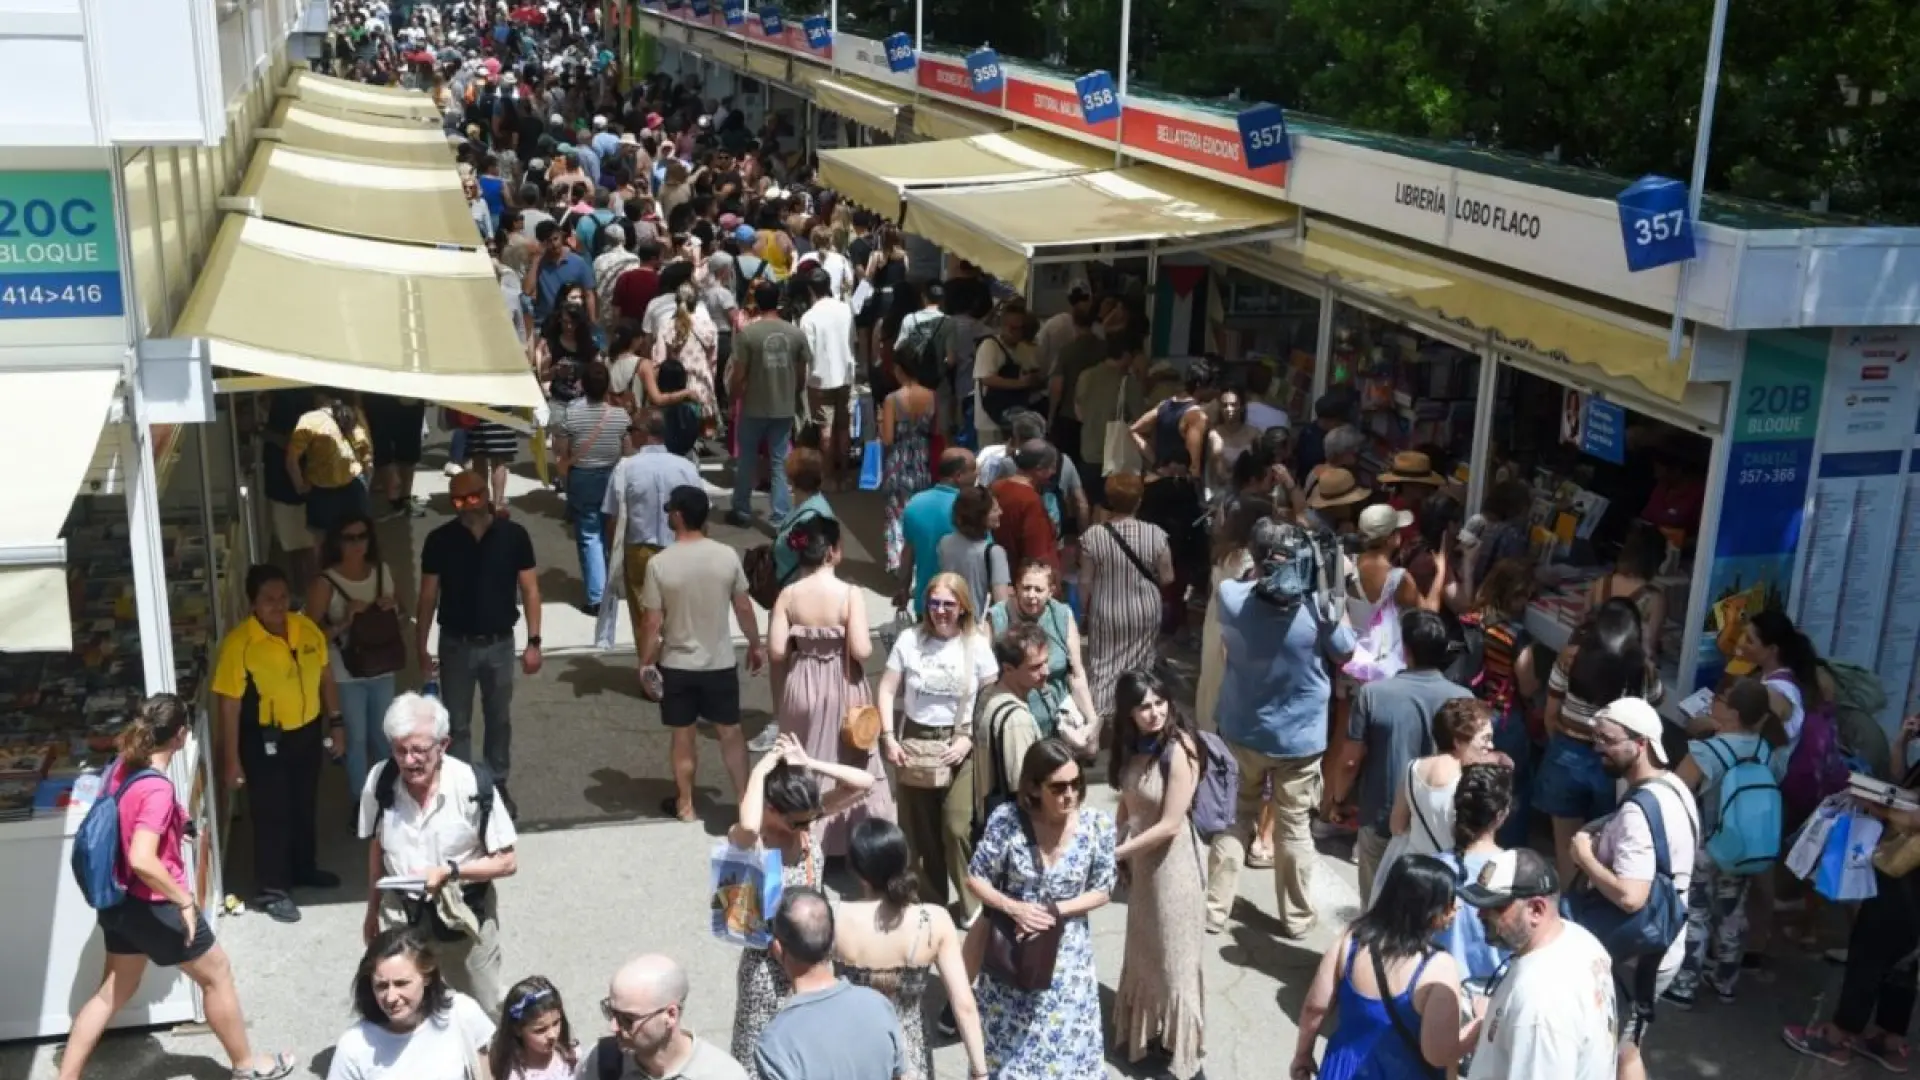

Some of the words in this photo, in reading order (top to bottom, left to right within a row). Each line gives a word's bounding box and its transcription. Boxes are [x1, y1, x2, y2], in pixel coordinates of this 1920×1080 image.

[973, 64, 998, 83] 359
[1083, 88, 1113, 111] 358
[1156, 124, 1202, 152] BELLATERRA
[1202, 135, 1240, 162] EDICIONS
[1249, 124, 1282, 150] 357
[0, 198, 97, 238] 20C
[1395, 182, 1446, 216] LIBRERÍA
[1455, 196, 1491, 226] LOBO
[1492, 206, 1540, 239] FLACO
[1634, 209, 1684, 246] 357
[0, 243, 99, 264] BLOQUE
[2, 284, 102, 304] 414>416
[1746, 384, 1811, 416] 20B
[1747, 416, 1803, 434] BLOQUE
